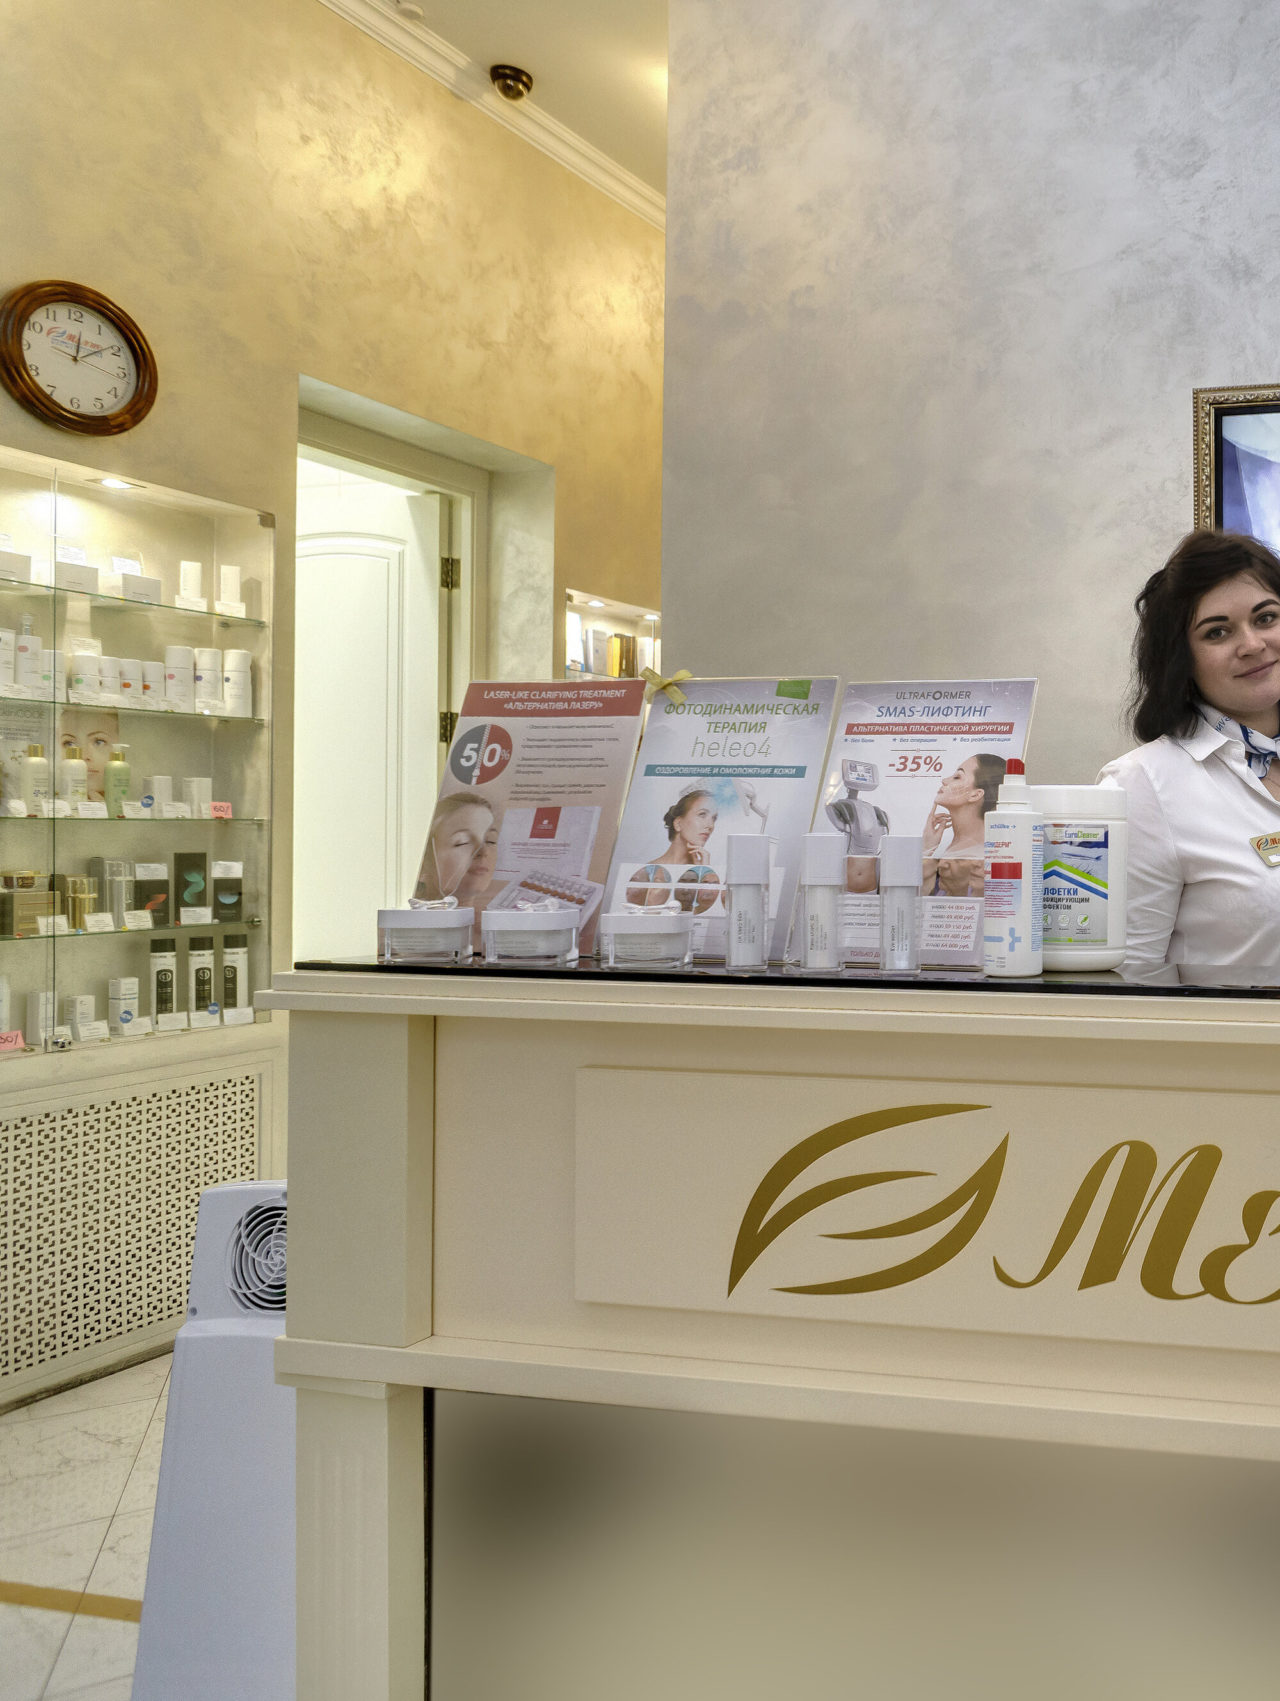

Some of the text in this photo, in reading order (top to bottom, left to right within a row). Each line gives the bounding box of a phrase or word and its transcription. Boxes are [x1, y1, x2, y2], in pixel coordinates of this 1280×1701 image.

[44, 307, 57, 322] 11
[67, 308, 84, 324] 12
[26, 319, 44, 334] 10
[97, 324, 102, 336] 1
[111, 344, 121, 358] 2
[28, 363, 40, 377] 8
[47, 384, 57, 397] 7
[107, 386, 119, 399] 4
[70, 397, 81, 410] 6
[93, 397, 104, 410] 5
[484, 689, 627, 699] LASER-LIKE CLARIFYING TREATMENT
[895, 690, 972, 701] ULTRAFORMER
[664, 702, 820, 718] ФОТОДИНАМИЧЕСКАЯ
[876, 705, 992, 718] SMAS-ЛИФТИНГ
[706, 721, 768, 734] ТЕРАПИЯ
[852, 724, 1010, 733] АЛЬТЕРНАТИВА ПЛАСТИЧЕСКОЙ ХИРУРГИИ
[690, 736, 773, 758] heleo4
[888, 755, 944, 773] -35%
